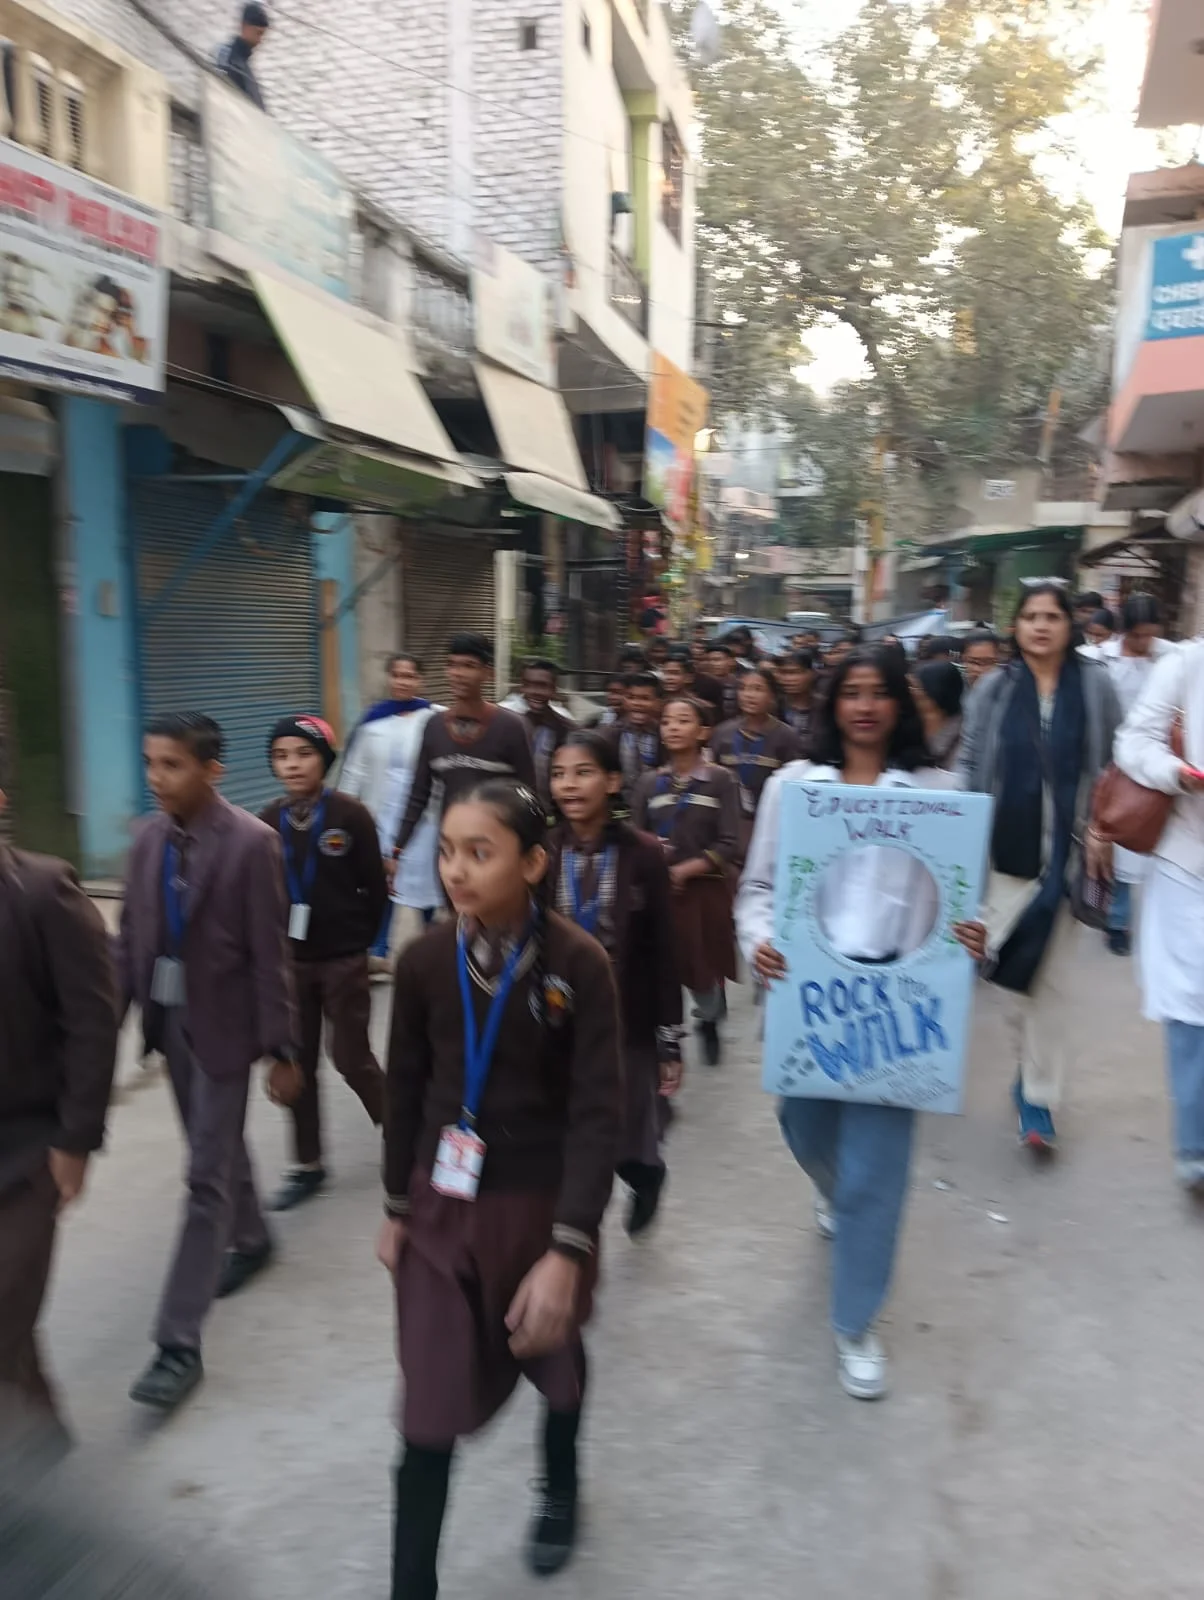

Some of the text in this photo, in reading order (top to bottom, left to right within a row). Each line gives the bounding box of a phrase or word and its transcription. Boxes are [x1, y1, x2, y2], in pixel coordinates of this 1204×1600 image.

[843, 817, 914, 840] WALK
[800, 974, 891, 1027] ROCK
[805, 996, 949, 1083] WALK
